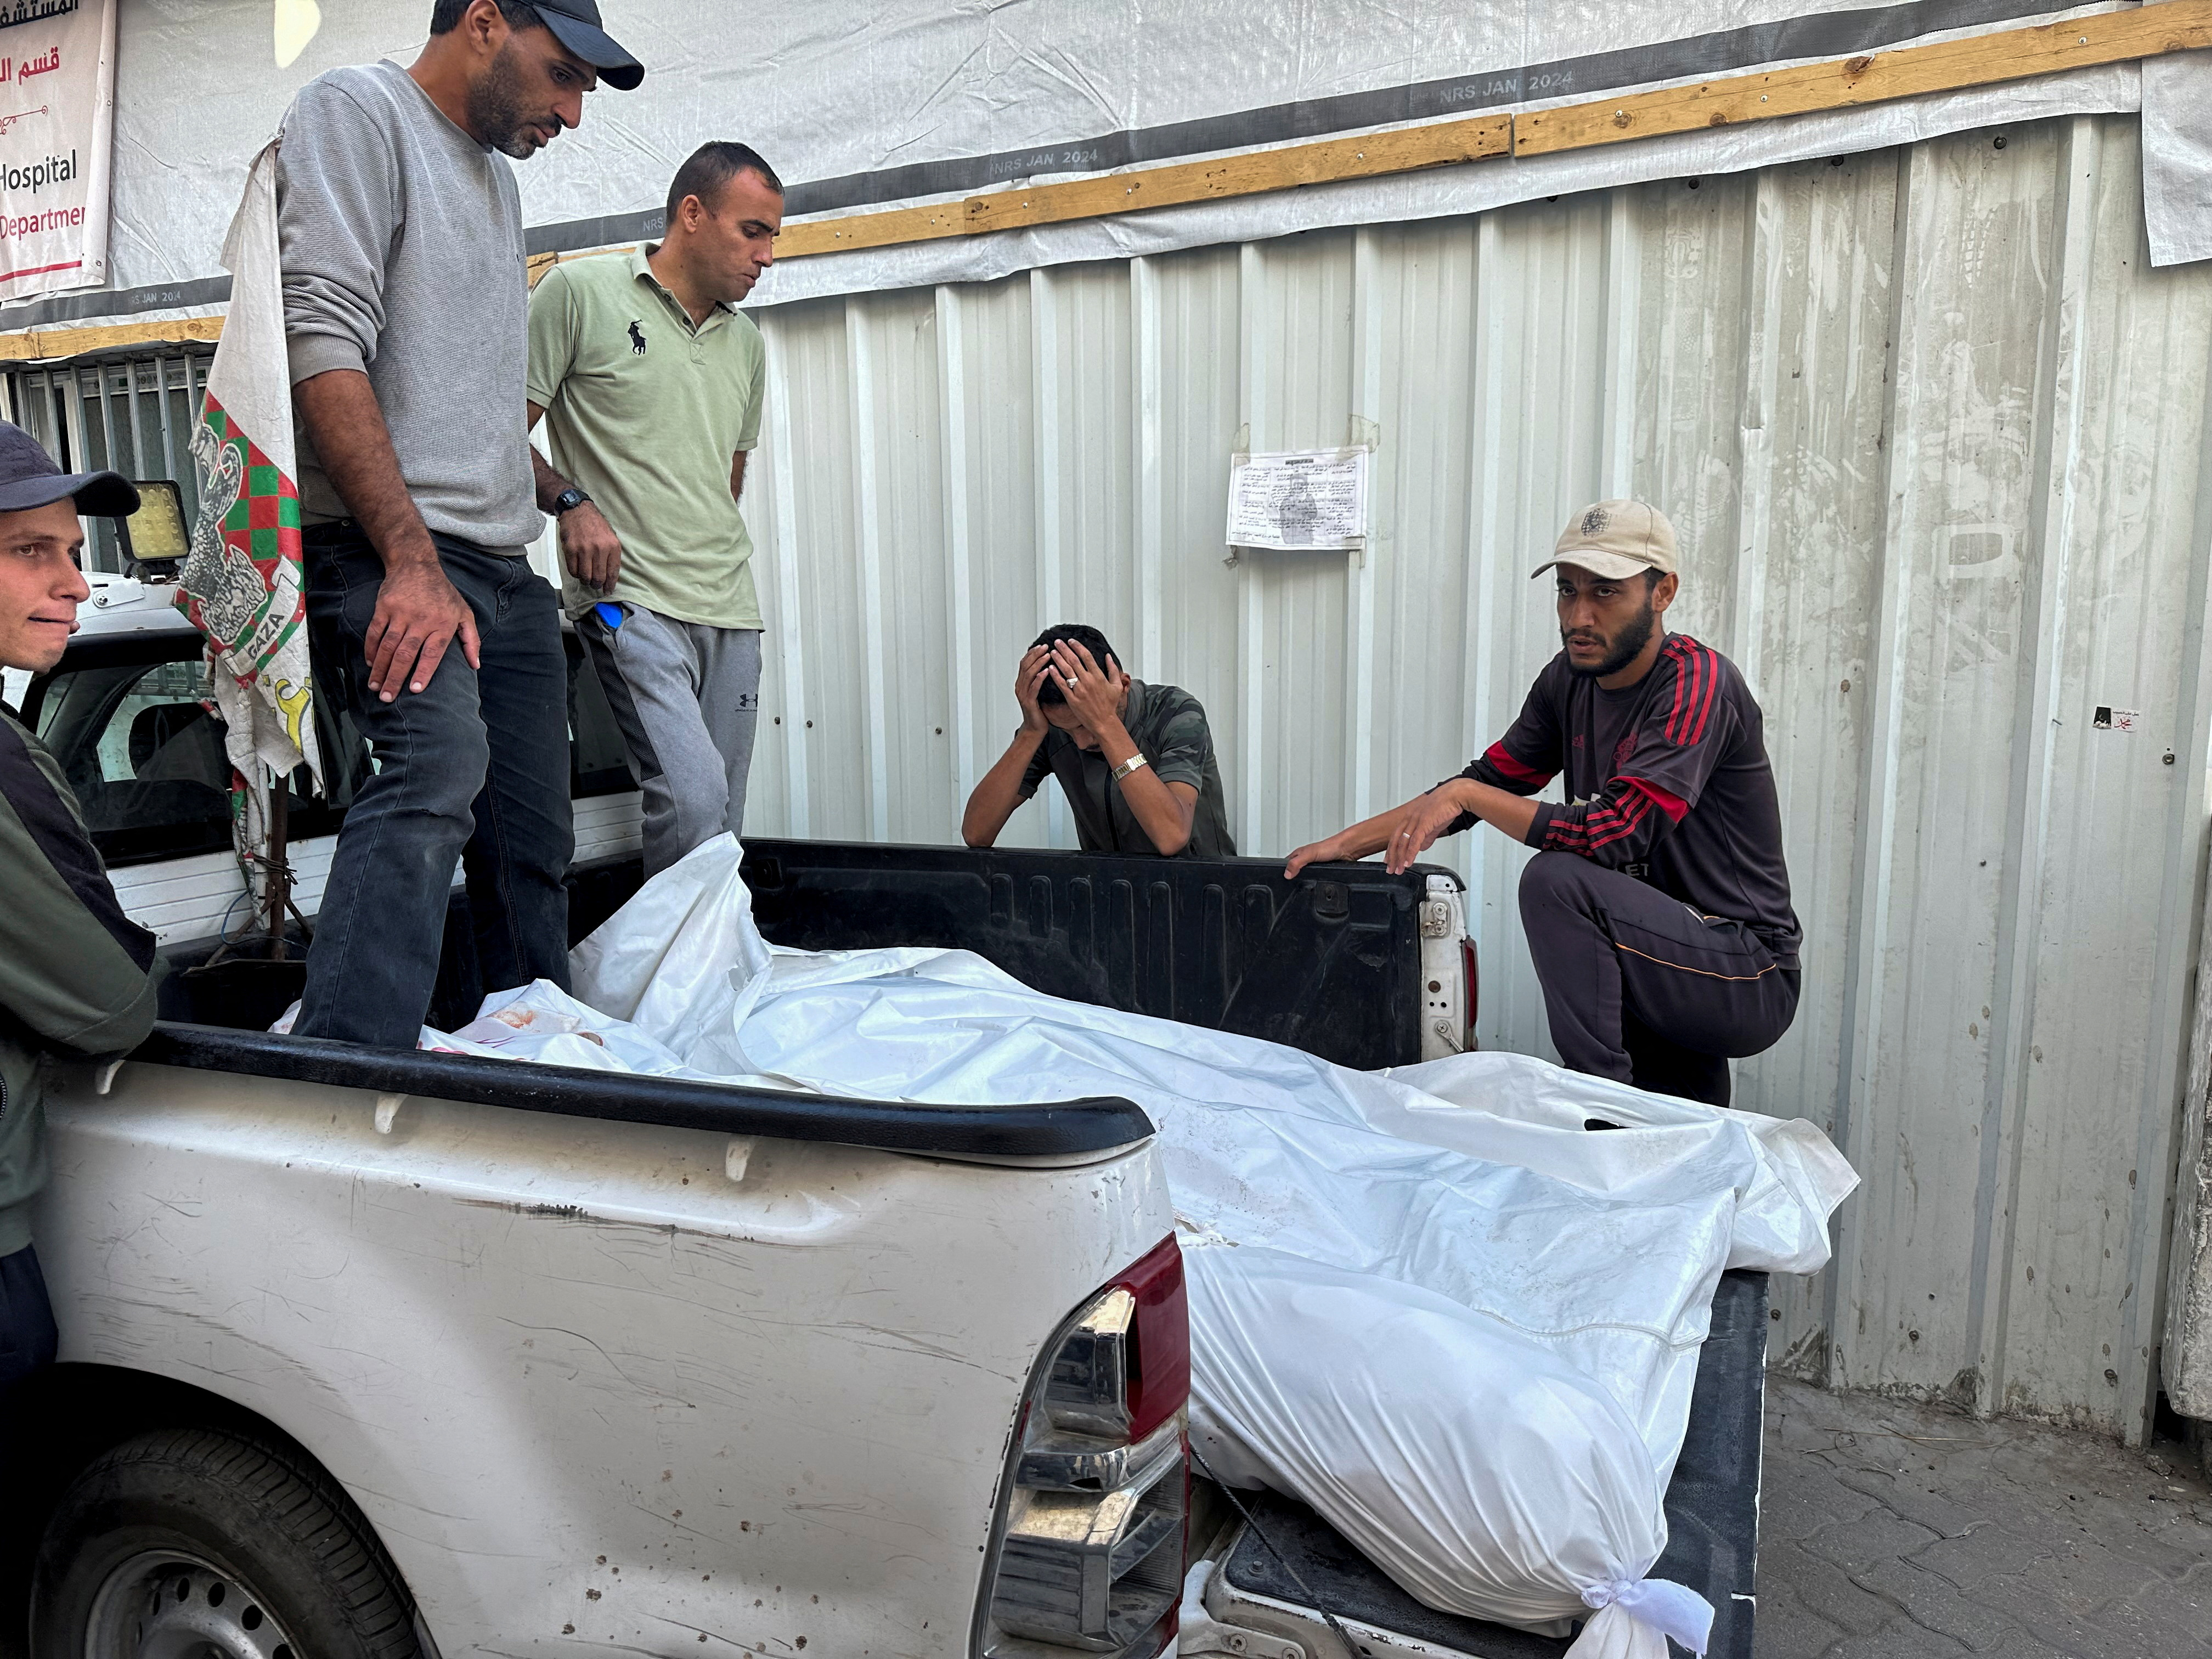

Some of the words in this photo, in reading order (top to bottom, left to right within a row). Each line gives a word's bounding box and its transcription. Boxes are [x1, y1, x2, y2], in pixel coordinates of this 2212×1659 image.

[18, 46, 59, 86] قسم
[1440, 85, 1475, 104] NRS
[1482, 78, 1517, 96] JAN
[1529, 71, 1572, 91] 2024
[995, 160, 1021, 174] NRS
[1027, 154, 1054, 167] JAN
[1062, 149, 1098, 163] 2024
[643, 217, 663, 232] NRS
[142, 292, 157, 303] JAN
[247, 613, 285, 661] GAZA
[1615, 863, 1649, 876] ET
